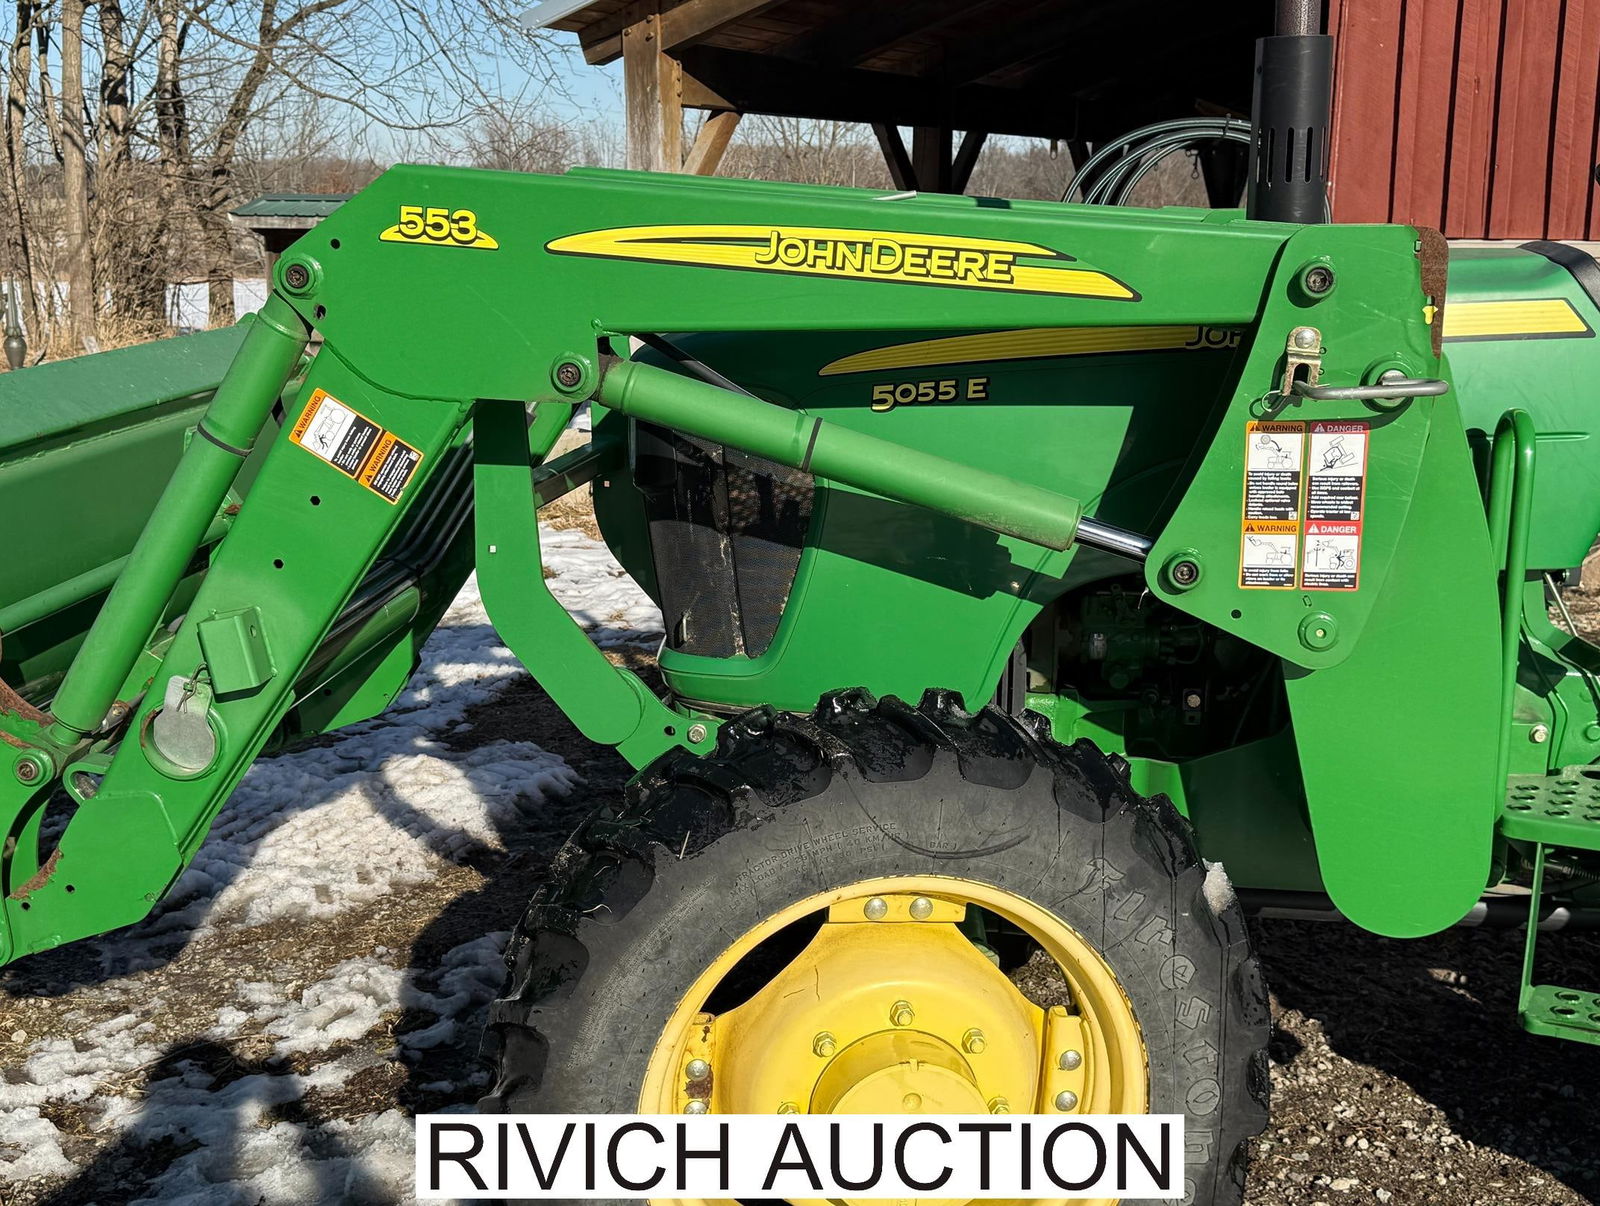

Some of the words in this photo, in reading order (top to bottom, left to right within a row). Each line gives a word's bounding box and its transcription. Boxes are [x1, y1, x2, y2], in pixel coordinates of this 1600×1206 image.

[399, 205, 478, 245] 553
[755, 231, 864, 272] JOHN
[869, 238, 1014, 285] DEERE
[871, 379, 957, 412] 5055
[967, 377, 988, 400] E
[298, 395, 321, 430] WARNING
[1262, 424, 1303, 432] WARNING
[1326, 424, 1364, 433] DANGER
[370, 439, 392, 472] WARNING
[1320, 526, 1357, 534] DANGER
[736, 855, 779, 882] TRACTOR
[781, 842, 810, 859] DRIVE
[813, 830, 849, 846] WHEEL
[852, 822, 896, 836] SERVICE
[752, 867, 777, 883] LOAD
